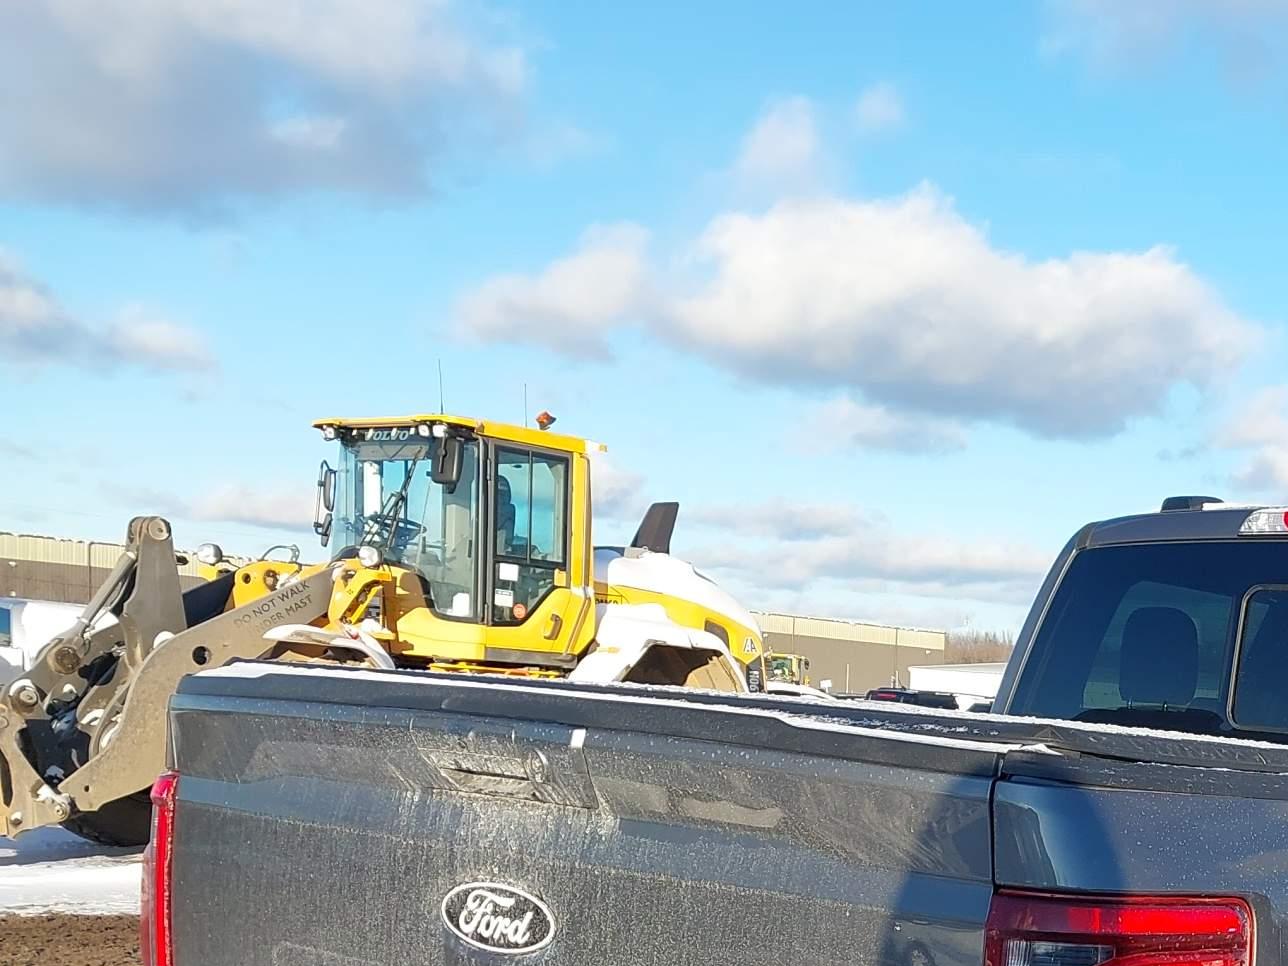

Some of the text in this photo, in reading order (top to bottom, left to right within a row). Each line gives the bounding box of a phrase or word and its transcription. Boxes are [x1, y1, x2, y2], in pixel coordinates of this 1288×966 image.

[364, 429, 409, 441] VOLVO
[252, 598, 277, 617] NOT
[279, 580, 310, 602] WALK
[284, 594, 313, 616] MAST
[459, 889, 534, 945] Ford
